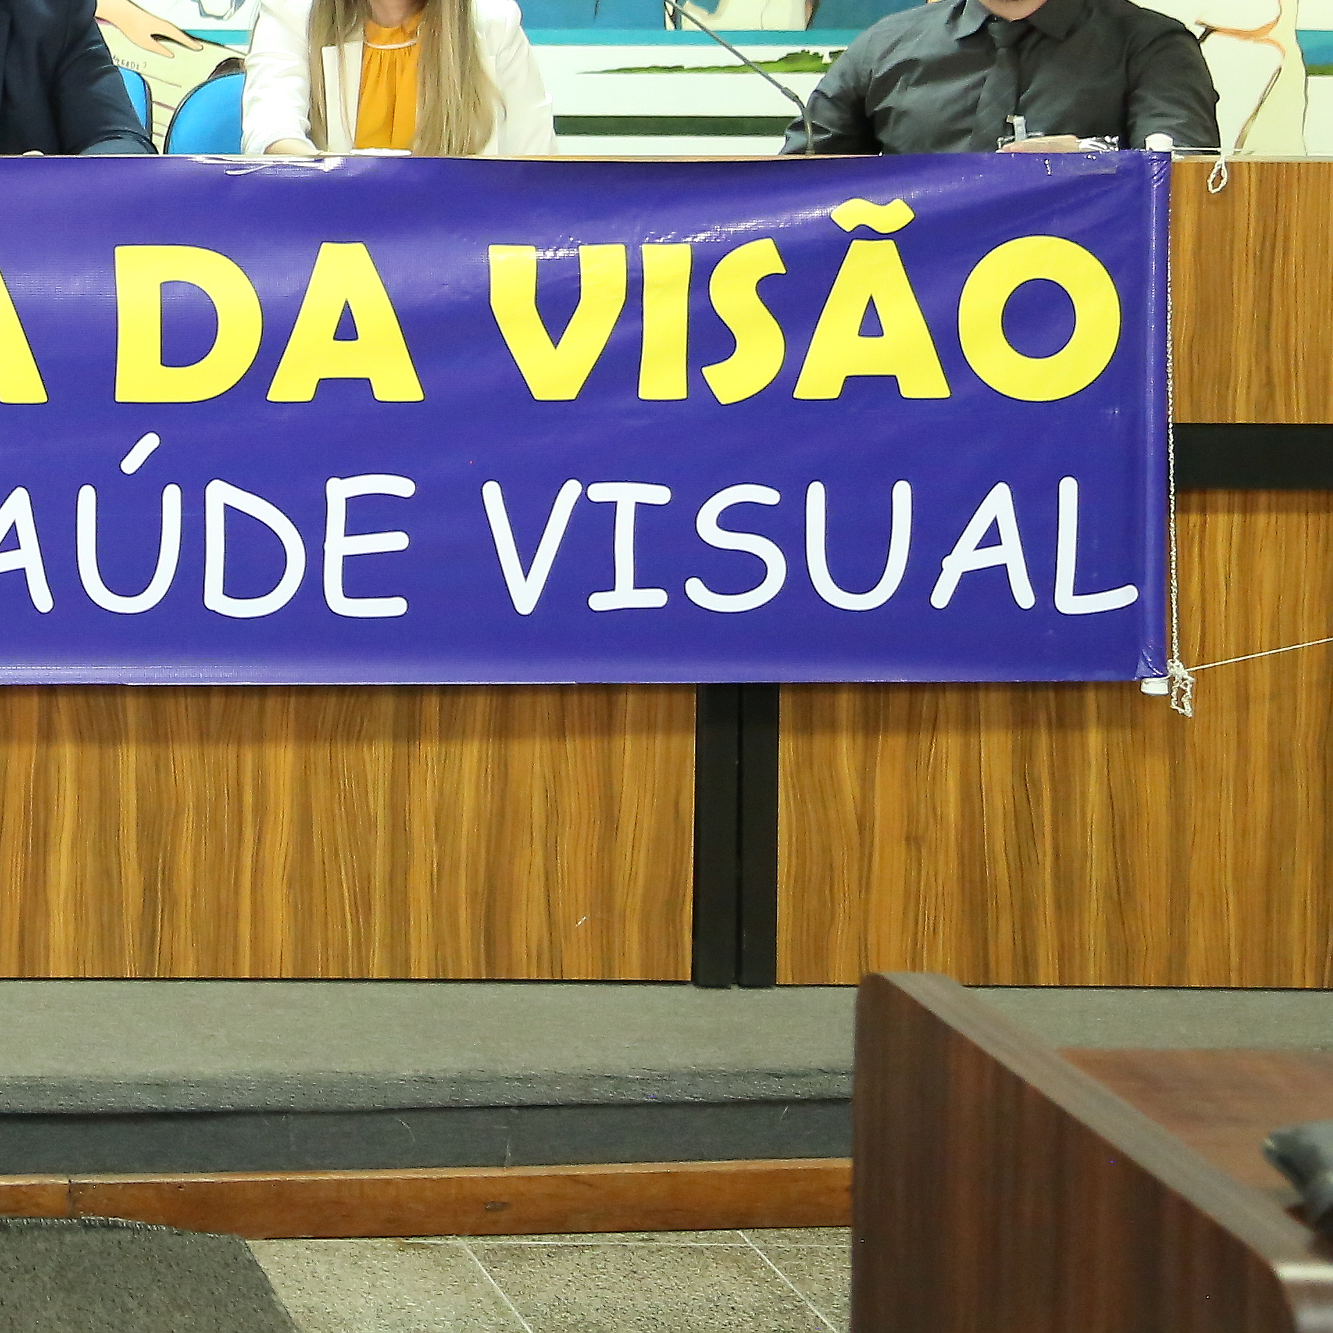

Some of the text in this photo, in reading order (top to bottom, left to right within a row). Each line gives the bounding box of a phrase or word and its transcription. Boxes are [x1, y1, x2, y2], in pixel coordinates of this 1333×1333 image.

[116, 242, 424, 403] DA
[491, 198, 1121, 405] VISÃO
[482, 476, 1139, 615] VISUAL
